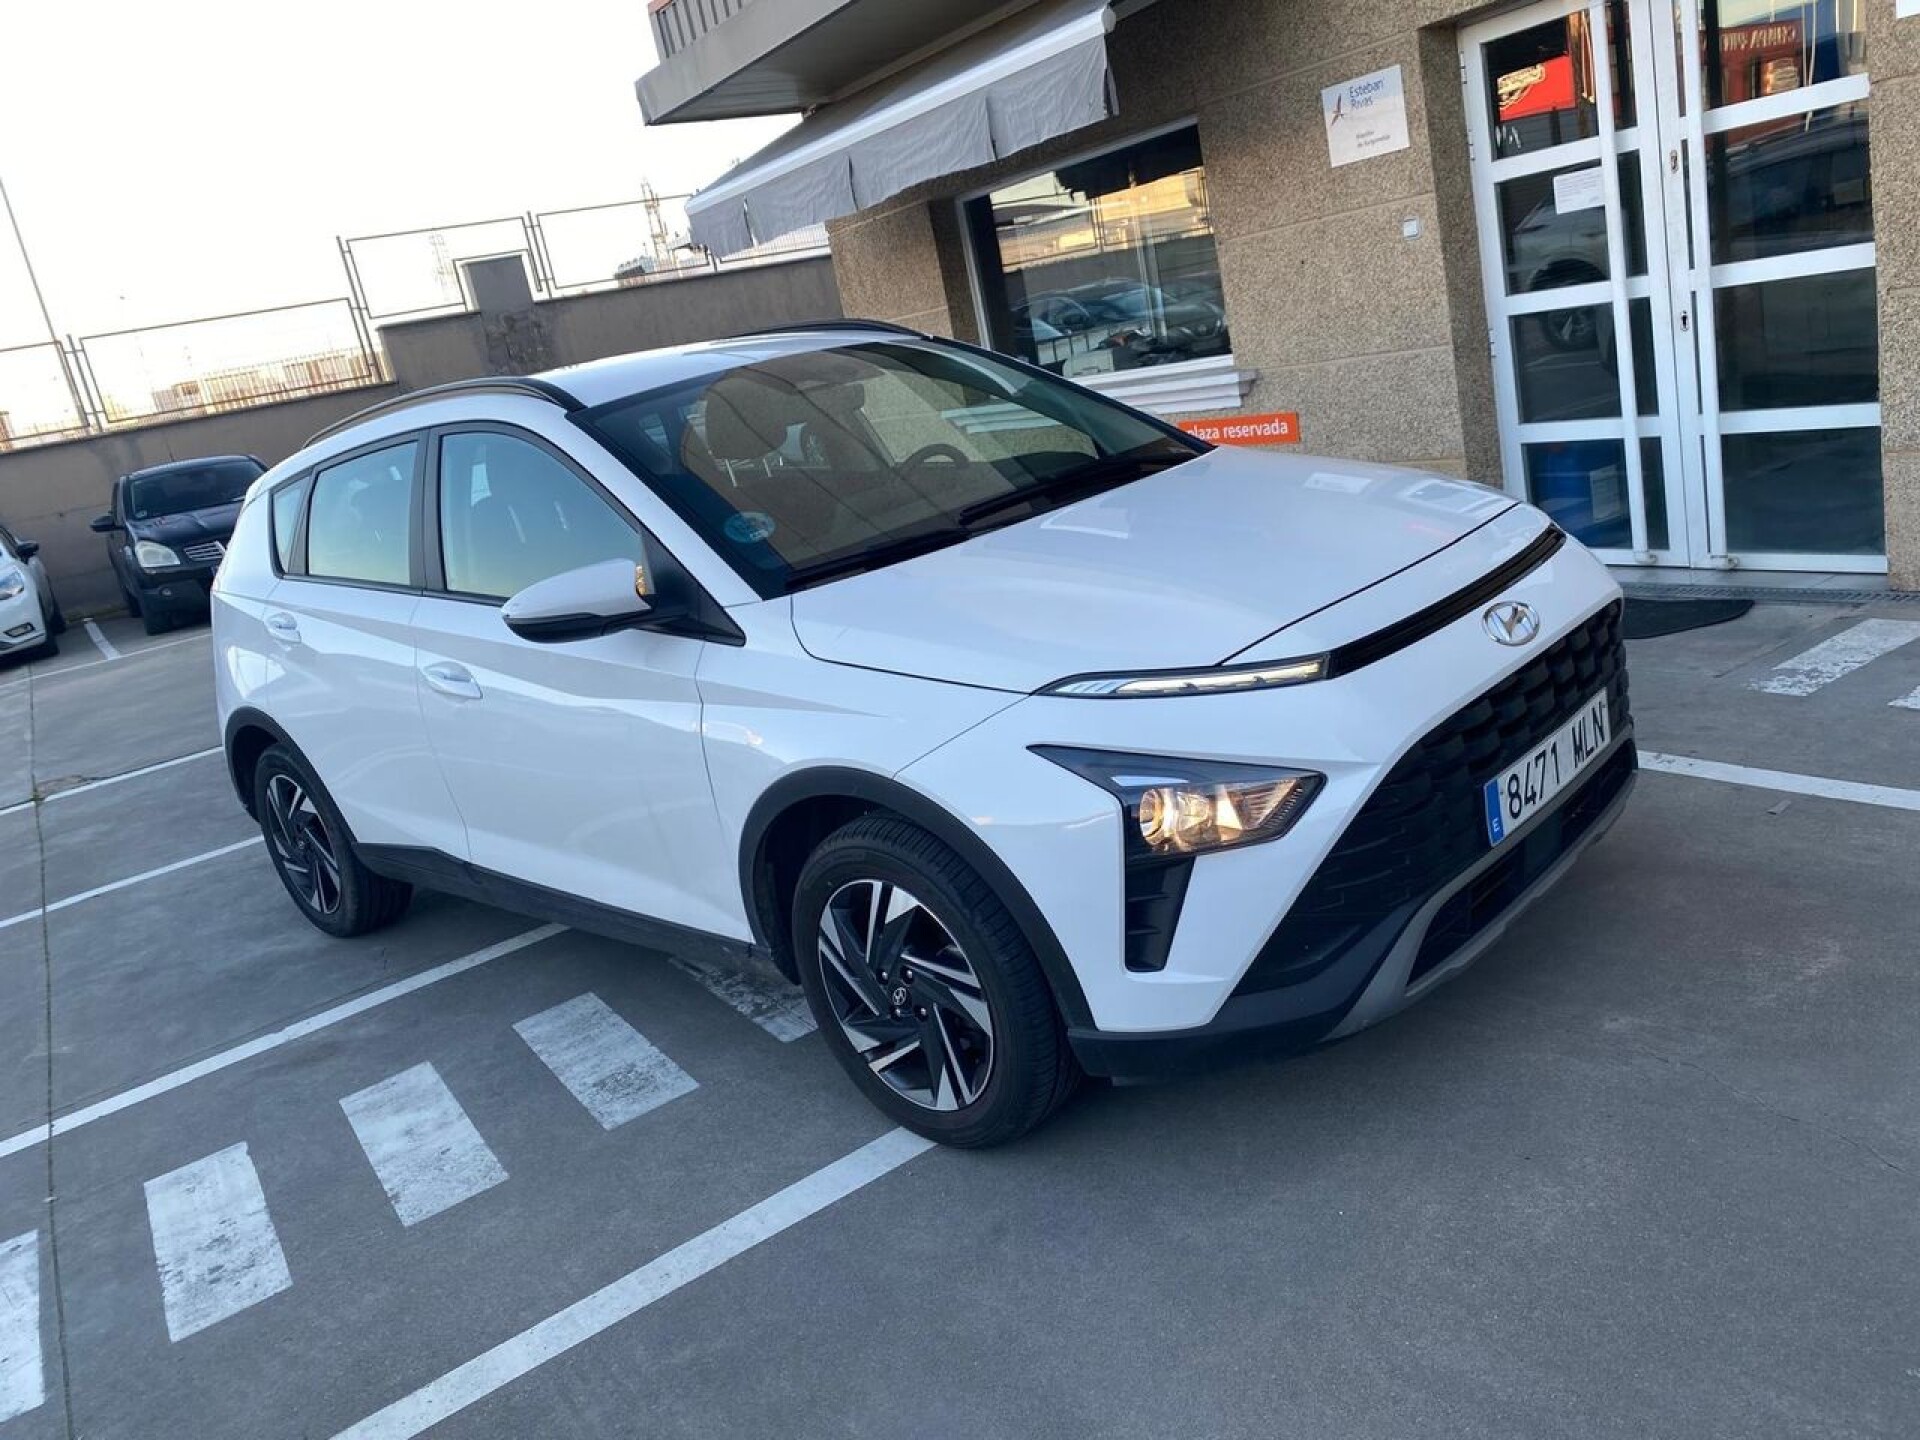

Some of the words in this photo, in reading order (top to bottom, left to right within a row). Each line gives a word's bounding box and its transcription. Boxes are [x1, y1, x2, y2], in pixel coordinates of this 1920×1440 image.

[1349, 79, 1384, 98] Esteban
[1223, 418, 1288, 438] reservada
[1507, 741, 1560, 819] 8471
[1571, 701, 1606, 768] MLN
[1491, 818, 1500, 832] E
